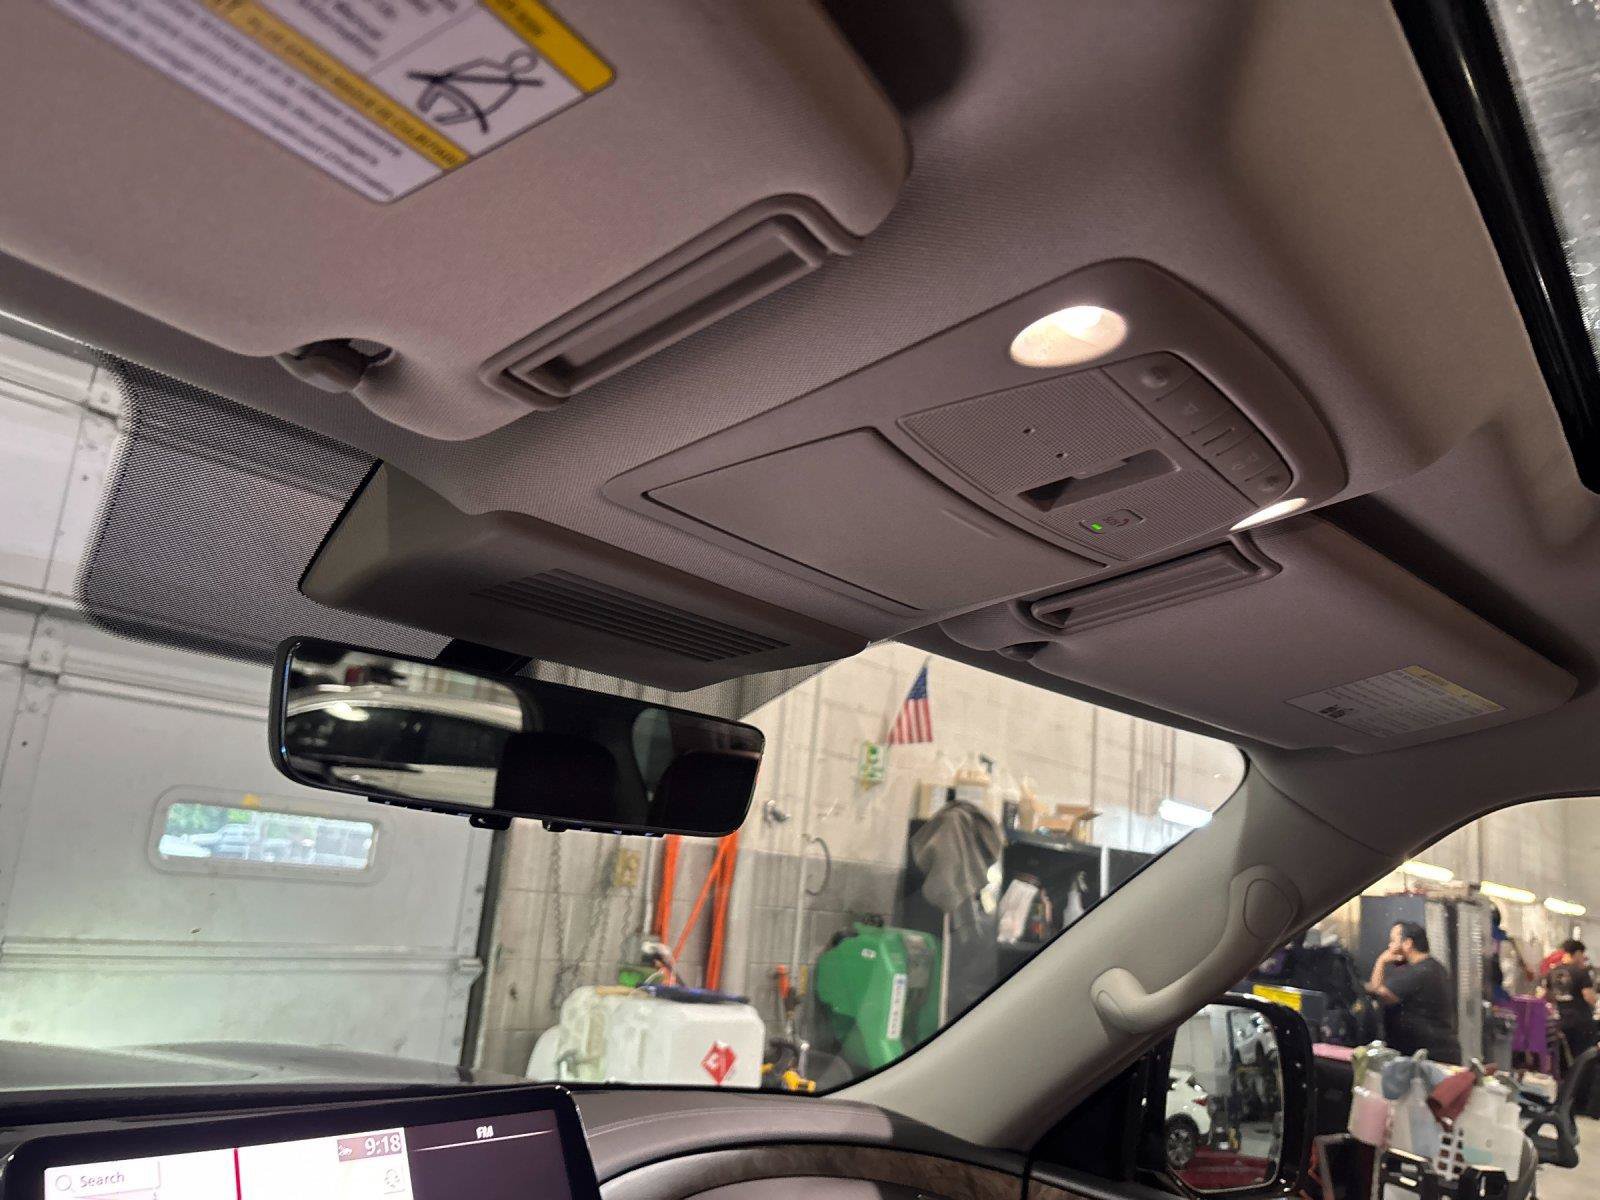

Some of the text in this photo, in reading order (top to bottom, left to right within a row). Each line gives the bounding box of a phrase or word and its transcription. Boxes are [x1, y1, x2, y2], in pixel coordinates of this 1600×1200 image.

[475, 1125, 494, 1139] FM
[365, 1134, 401, 1156] 9:18
[79, 1172, 125, 1188] Search
